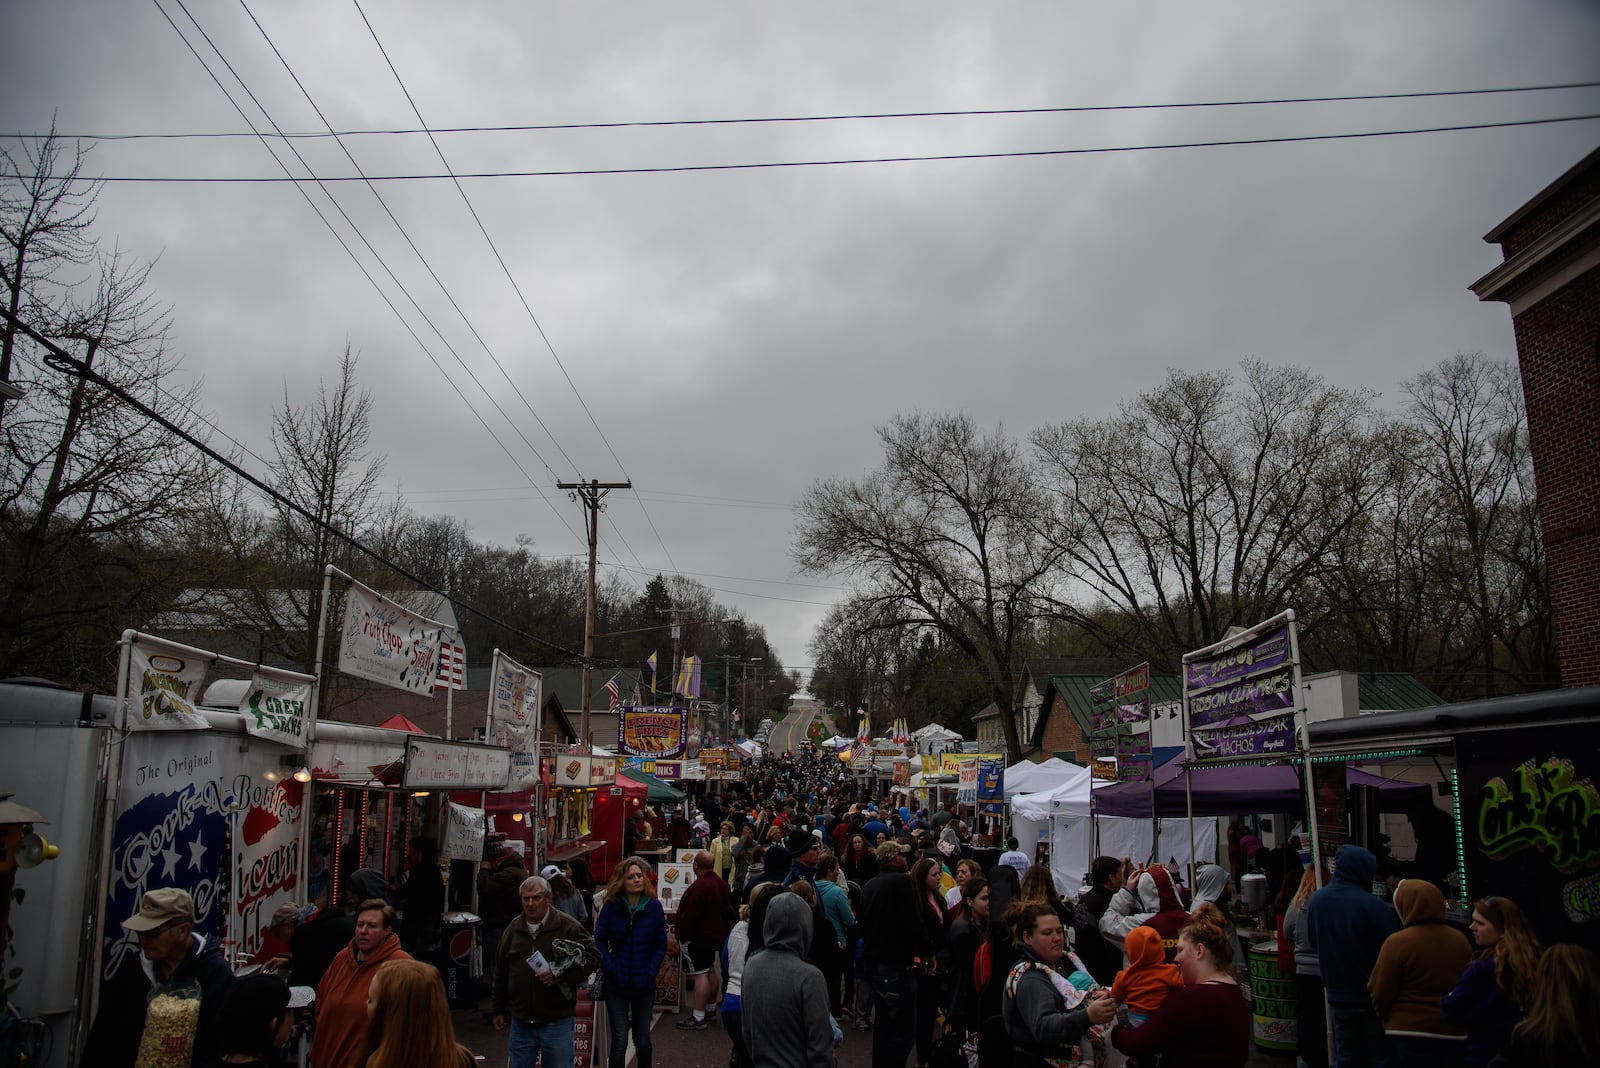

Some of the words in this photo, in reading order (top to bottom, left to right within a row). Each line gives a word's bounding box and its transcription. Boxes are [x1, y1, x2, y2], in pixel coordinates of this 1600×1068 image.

[627, 715, 679, 730] FRENCH
[1256, 718, 1288, 735] STEAK
[636, 726, 669, 738] FRIES
[136, 764, 160, 786] The
[167, 751, 212, 777] Original
[448, 967, 458, 999] pepsi
[1255, 1000, 1297, 1019] DEW
